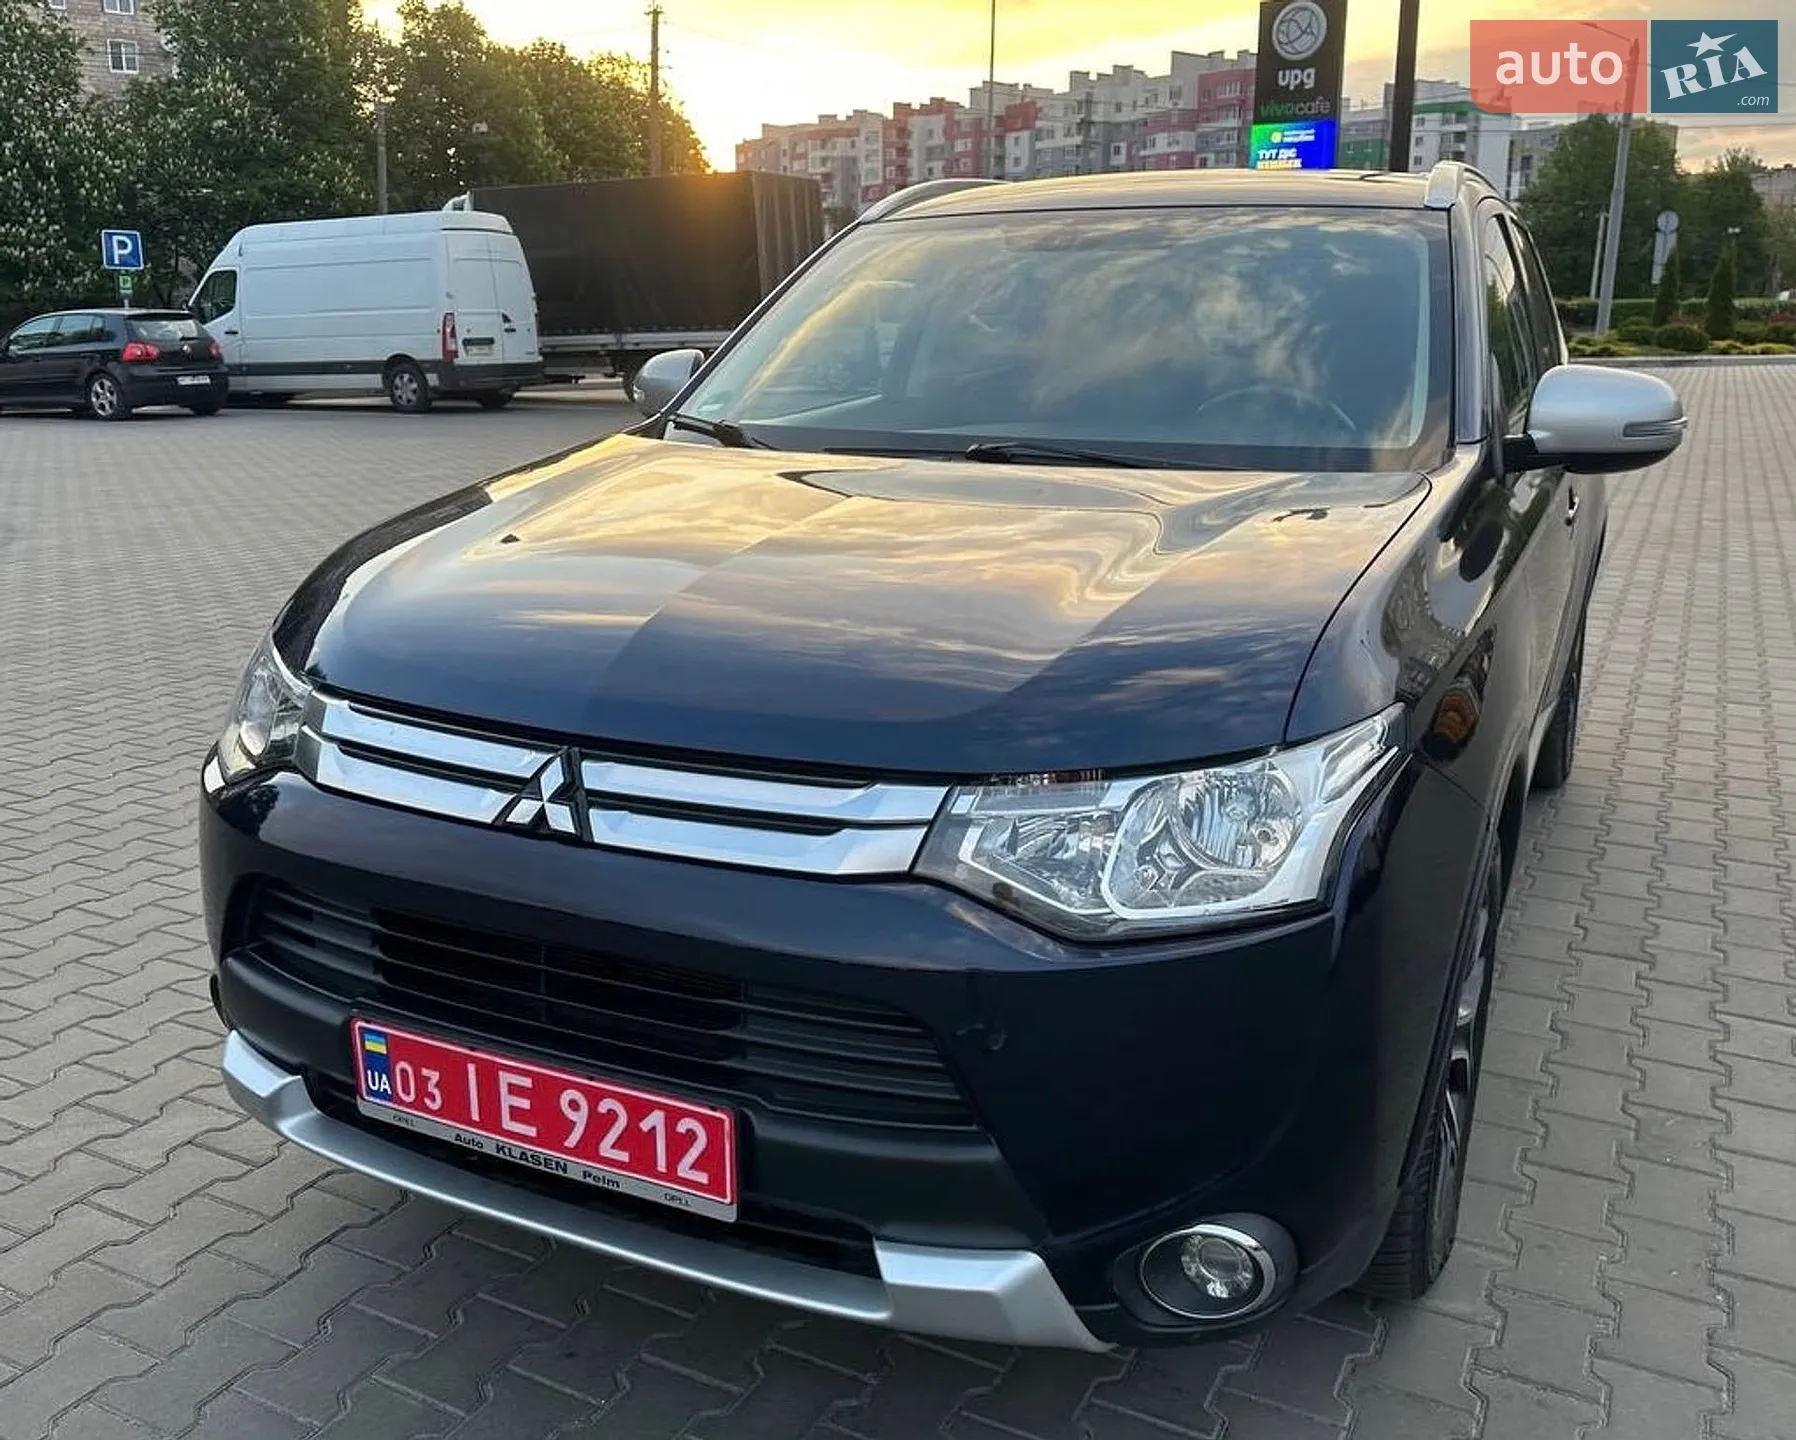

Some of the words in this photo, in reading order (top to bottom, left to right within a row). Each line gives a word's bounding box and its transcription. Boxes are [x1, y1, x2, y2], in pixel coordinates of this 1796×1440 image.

[1278, 67, 1316, 91] upg
[112, 235, 133, 264] P
[367, 1069, 392, 1095] UA
[559, 1089, 710, 1185] 9212
[454, 1133, 484, 1149] Auto
[495, 1143, 568, 1174] KLASEN
